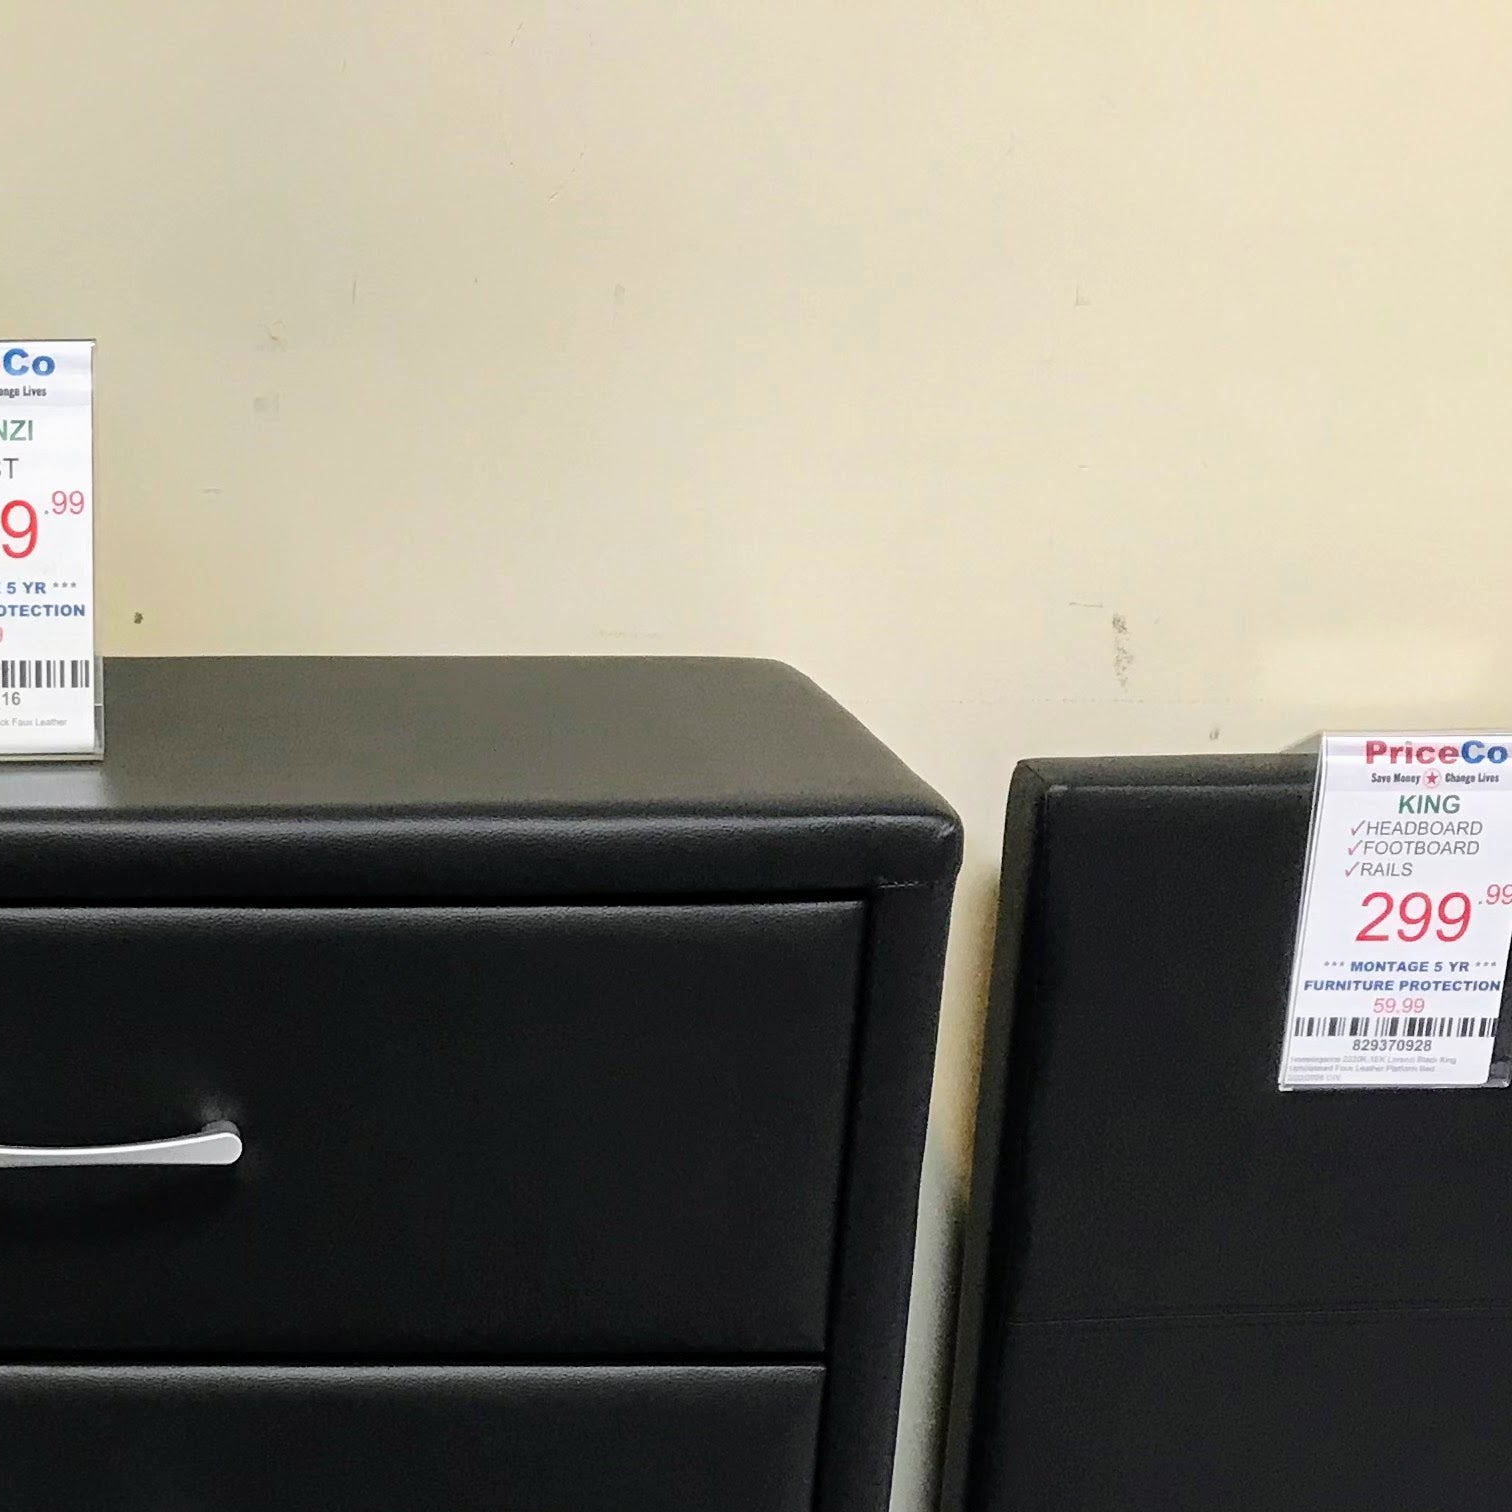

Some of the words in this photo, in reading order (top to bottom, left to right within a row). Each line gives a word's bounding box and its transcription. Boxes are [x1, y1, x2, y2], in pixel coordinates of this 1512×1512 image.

[23, 385, 47, 397] Lives
[6, 582, 16, 594] 5
[22, 582, 47, 594] YR
[12, 718, 33, 727] Faux
[35, 718, 67, 727] Leather
[1366, 740, 1508, 764] PriceCo
[1371, 773, 1391, 783] Save
[1394, 773, 1421, 785] Money
[1445, 773, 1476, 784] Change
[1478, 773, 1500, 783] Lives
[1398, 795, 1461, 814] KING
[1366, 821, 1483, 836] HEADBOARD
[1363, 841, 1480, 855] FOOTBOARD
[1360, 862, 1413, 877] RAILS
[1355, 892, 1471, 942] 299
[1350, 961, 1428, 972] MONTAGE
[1434, 961, 1443, 972] 5
[1450, 961, 1470, 972] YR
[1303, 980, 1394, 991] FURNITURE
[1399, 980, 1501, 992] PROTECTION
[1373, 998, 1425, 1013] 59.99
[1352, 1039, 1432, 1052] 829370928
